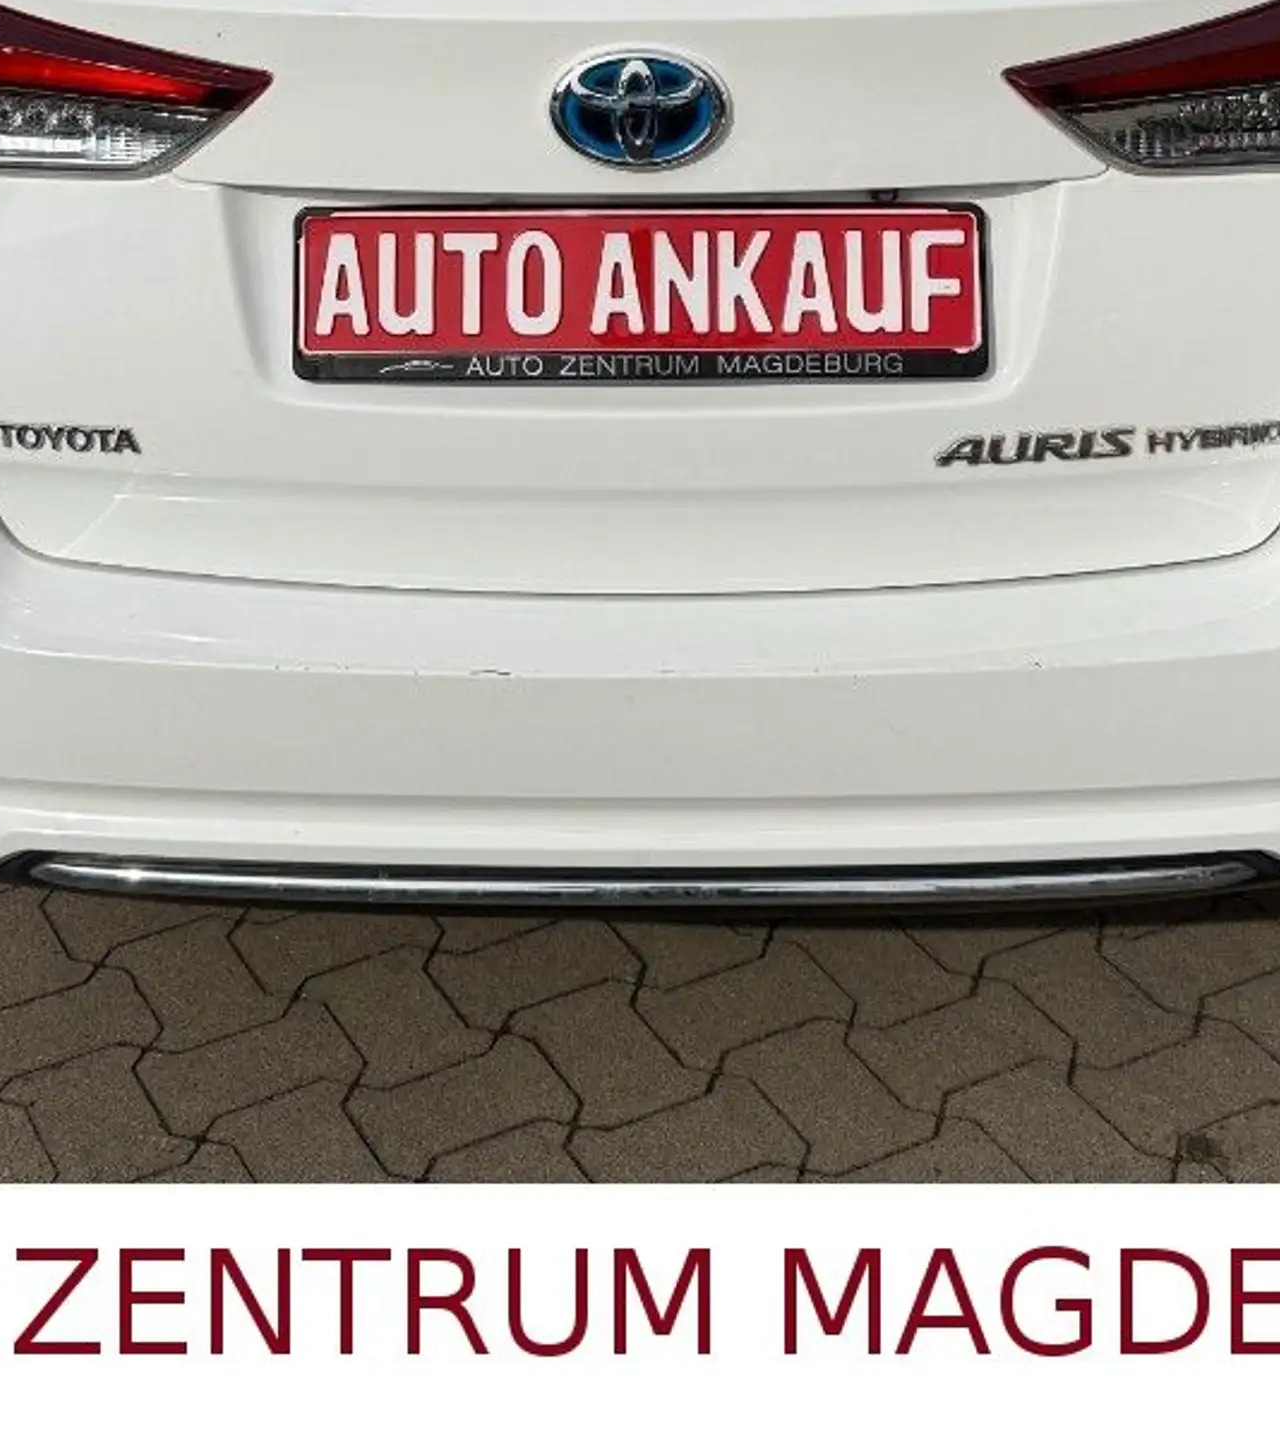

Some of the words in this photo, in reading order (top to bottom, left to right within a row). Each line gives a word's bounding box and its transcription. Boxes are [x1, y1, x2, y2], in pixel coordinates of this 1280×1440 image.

[315, 230, 563, 335] AUTO
[589, 228, 967, 334] ANKAUF
[466, 355, 543, 377] AUTO
[559, 354, 700, 376] ZENTRUM
[716, 352, 904, 375] MAGDEBURG
[934, 425, 1136, 466] AURIS
